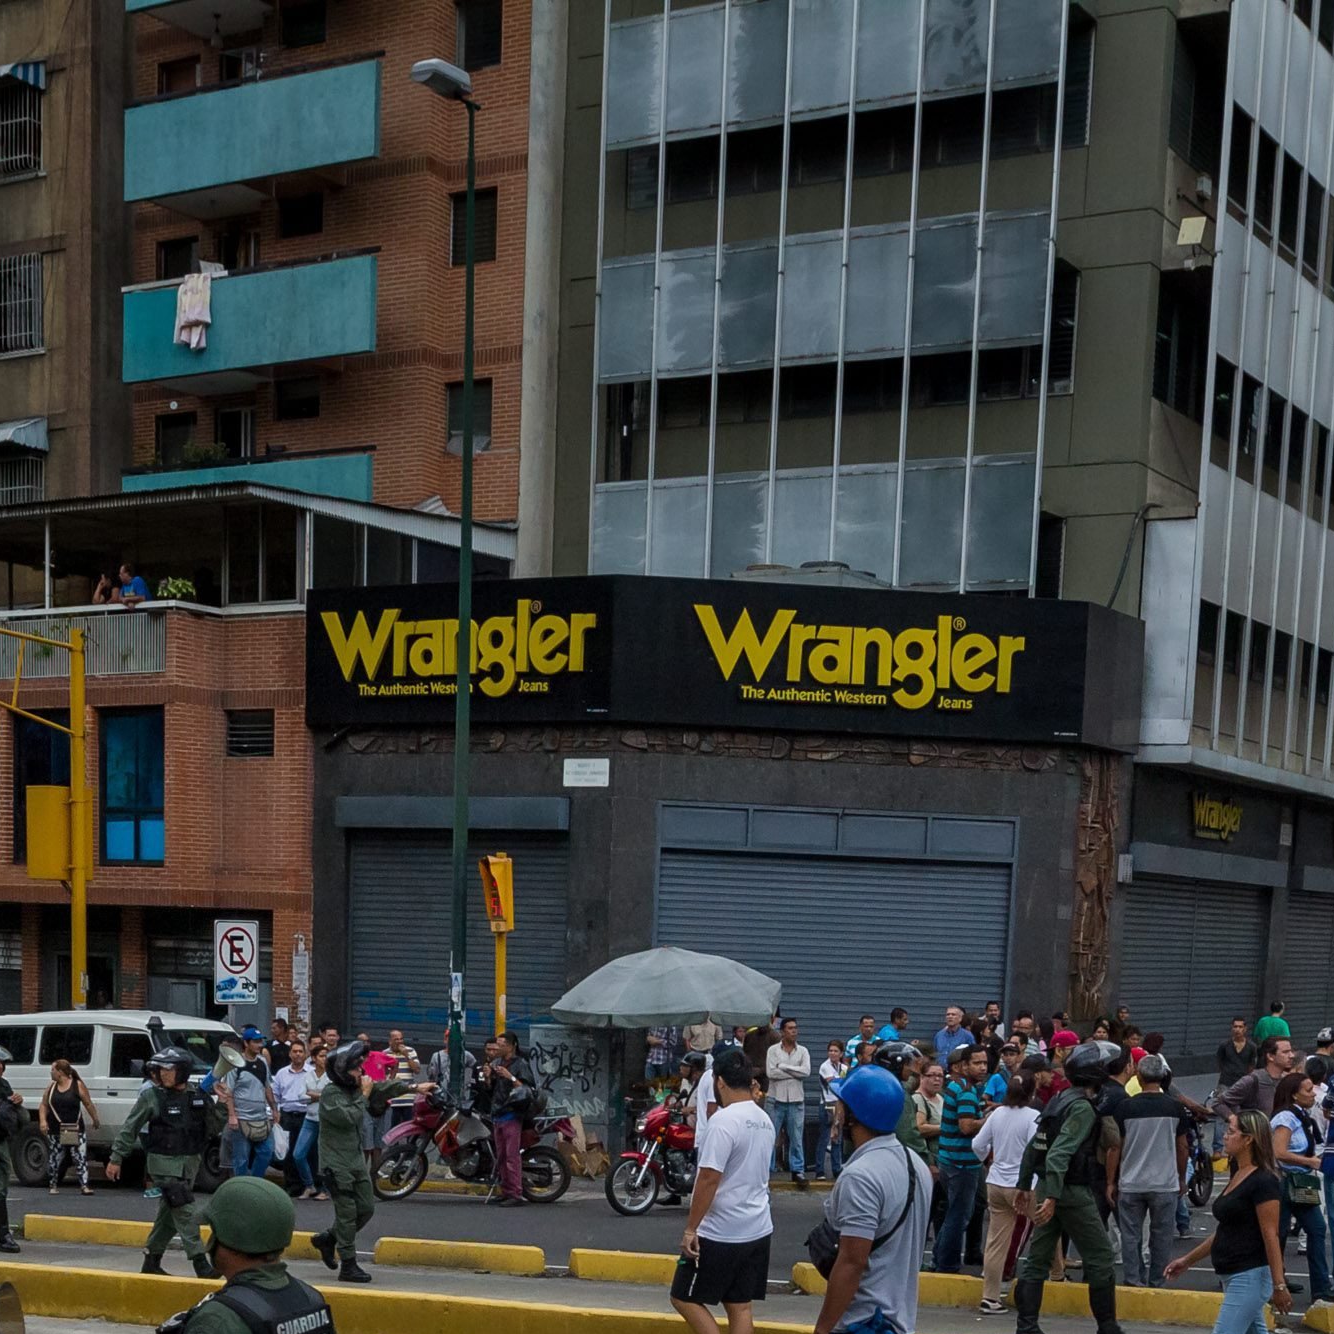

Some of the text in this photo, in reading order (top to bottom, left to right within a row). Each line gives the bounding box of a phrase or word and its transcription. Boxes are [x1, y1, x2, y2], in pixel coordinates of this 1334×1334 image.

[319, 598, 597, 698] Wrangler
[693, 603, 1026, 711] Wrangler
[358, 680, 549, 696] The Authentic West Jeans
[741, 685, 974, 710] The Authentic Western Jeans
[229, 935, 246, 967] E
